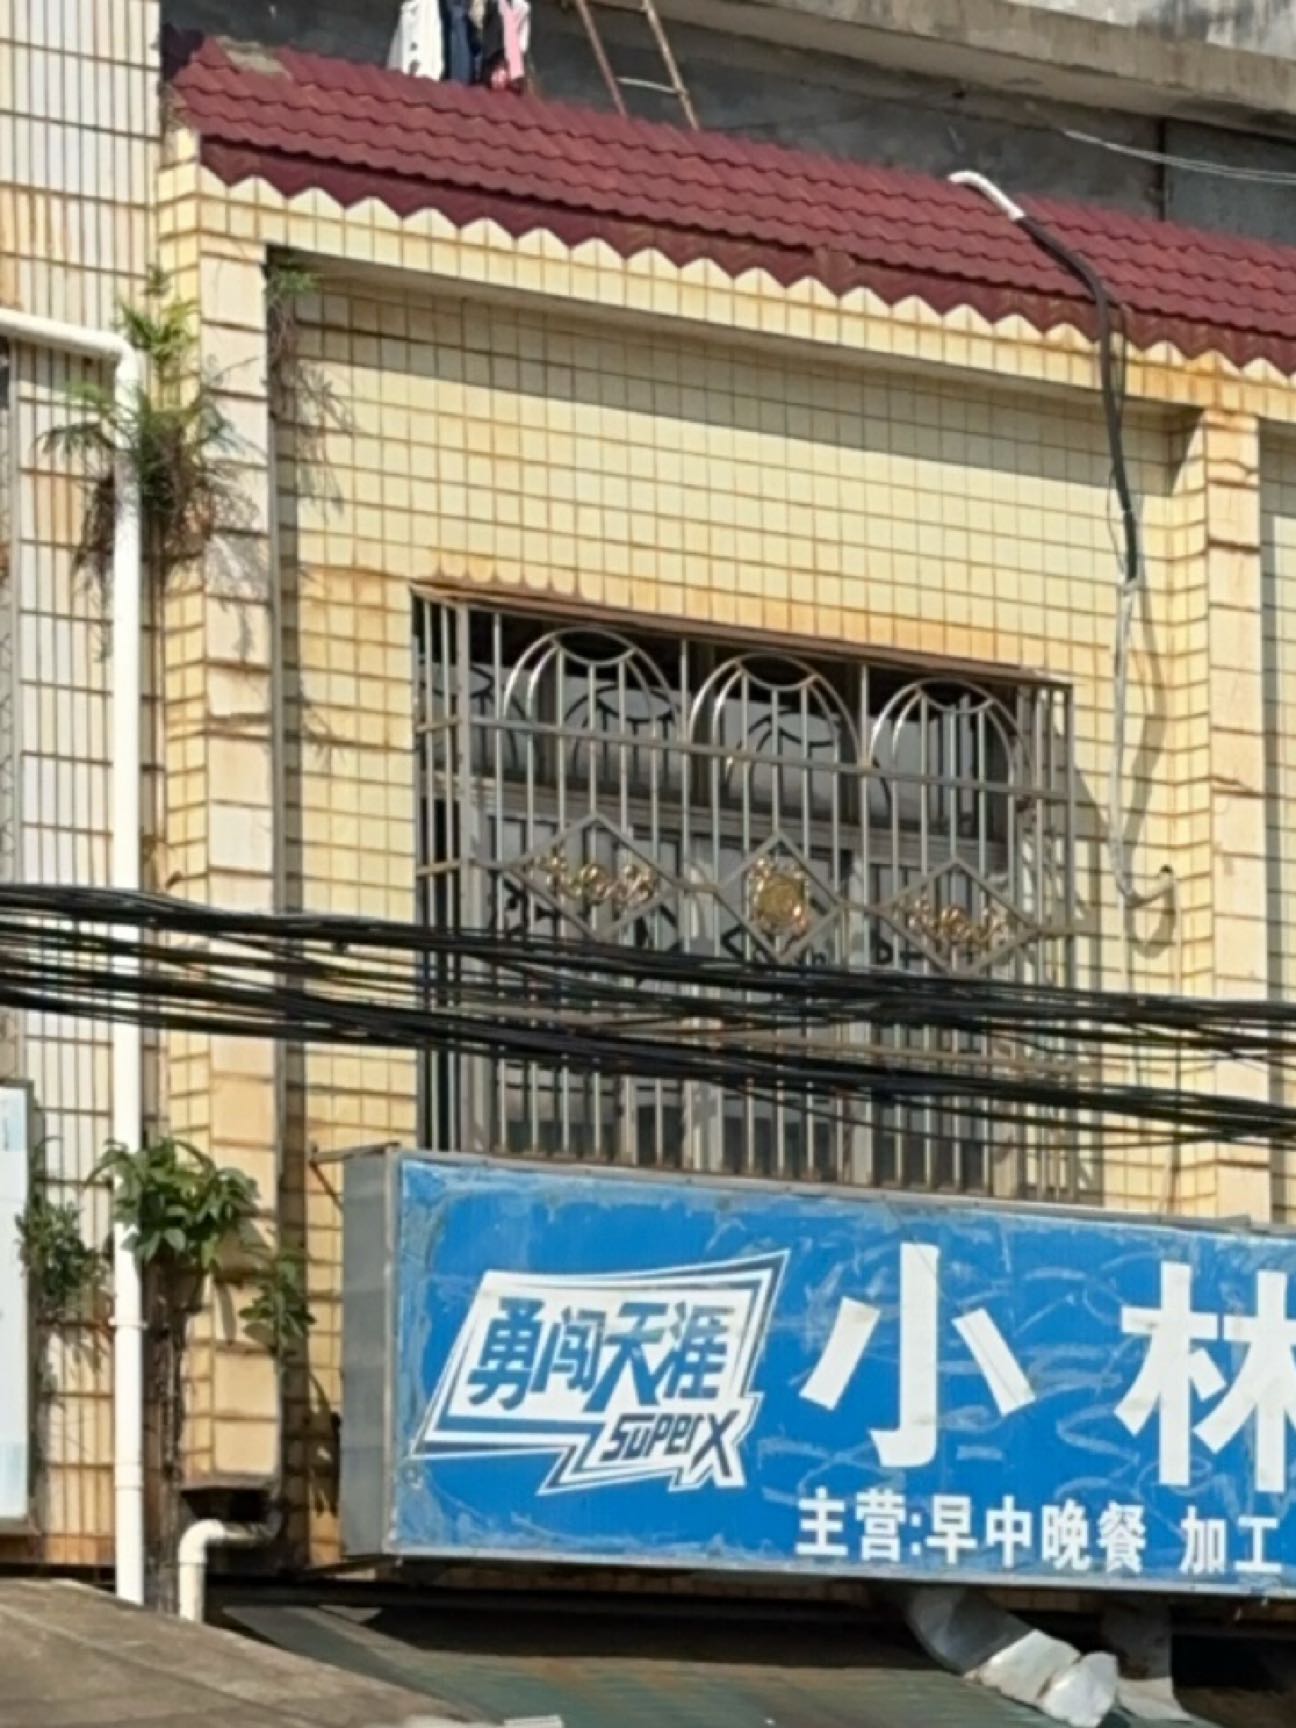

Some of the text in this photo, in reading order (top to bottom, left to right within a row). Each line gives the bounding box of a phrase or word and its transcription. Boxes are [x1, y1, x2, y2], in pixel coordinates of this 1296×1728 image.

[467, 1296, 735, 1412] 勇闯天涯
[795, 1486, 1147, 1575] 主营:早中晚餐
[1179, 1505, 1282, 1576] 加工
